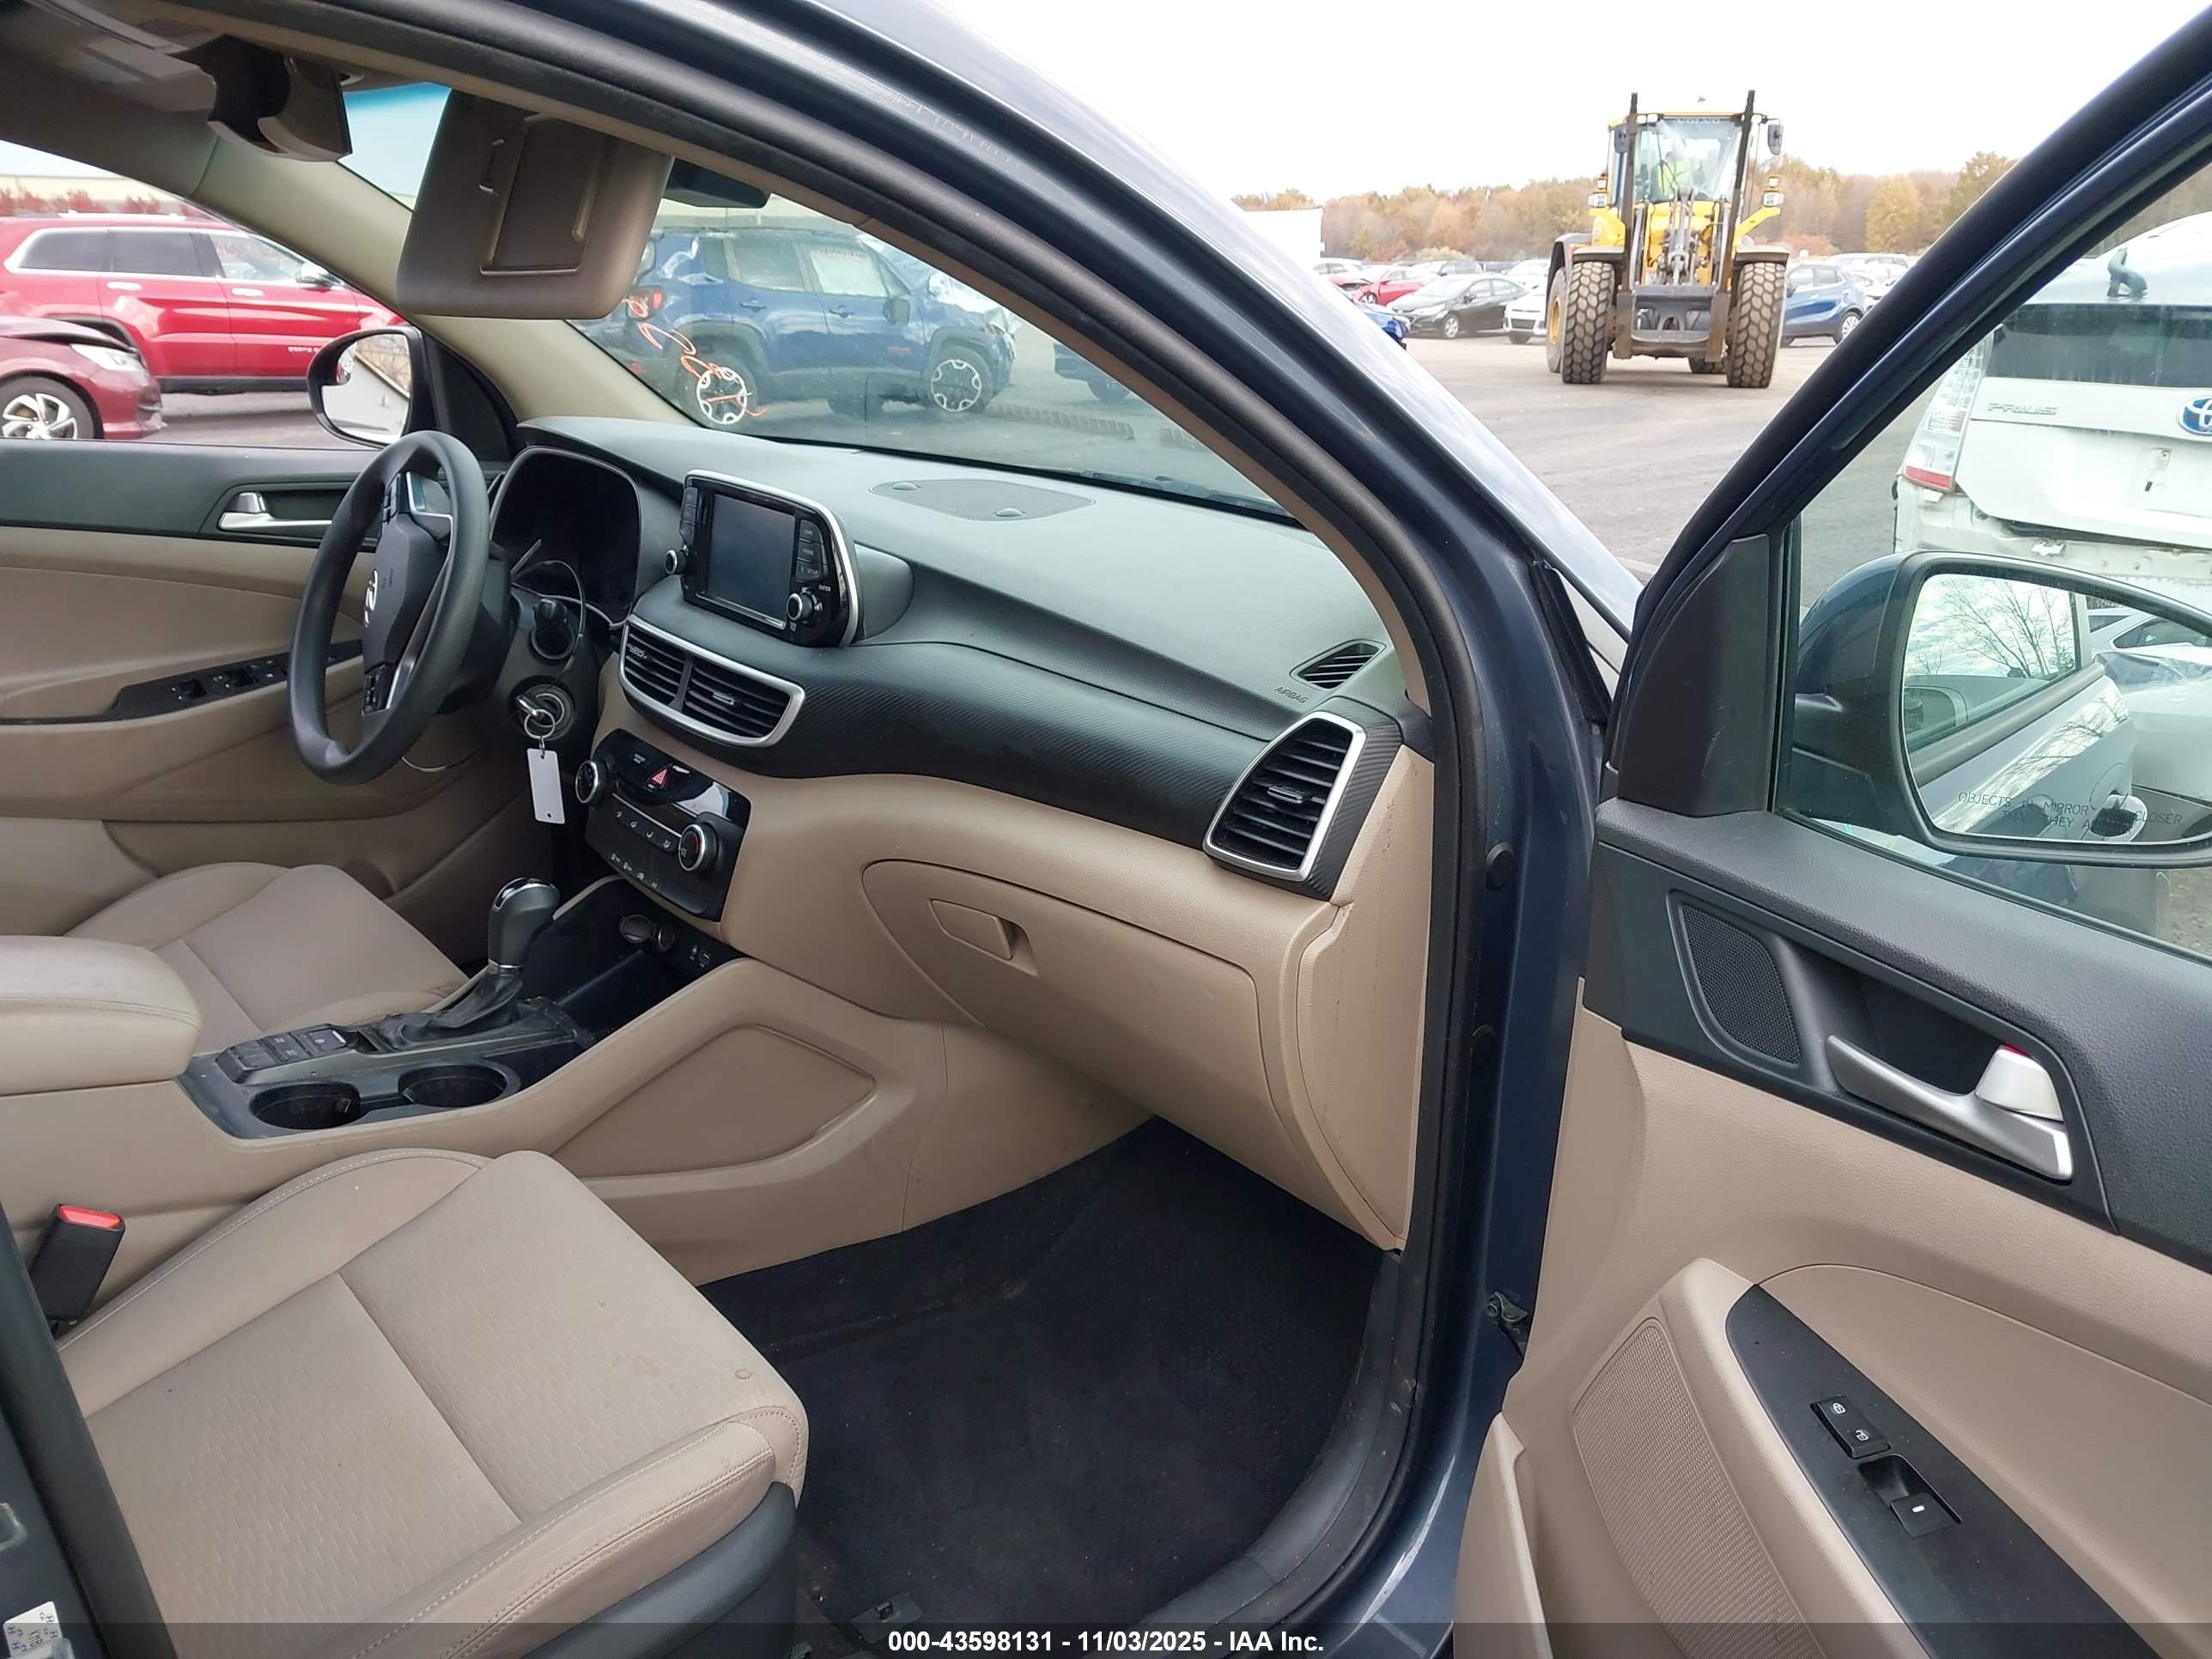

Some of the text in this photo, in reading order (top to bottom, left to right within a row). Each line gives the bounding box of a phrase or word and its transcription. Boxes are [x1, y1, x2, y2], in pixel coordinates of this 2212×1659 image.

[1274, 686, 1309, 703] AIRBAG
[1958, 791, 2012, 808] OBJECTS
[2044, 801, 2089, 816] MIRROR
[2135, 810, 2184, 825] CLOSER
